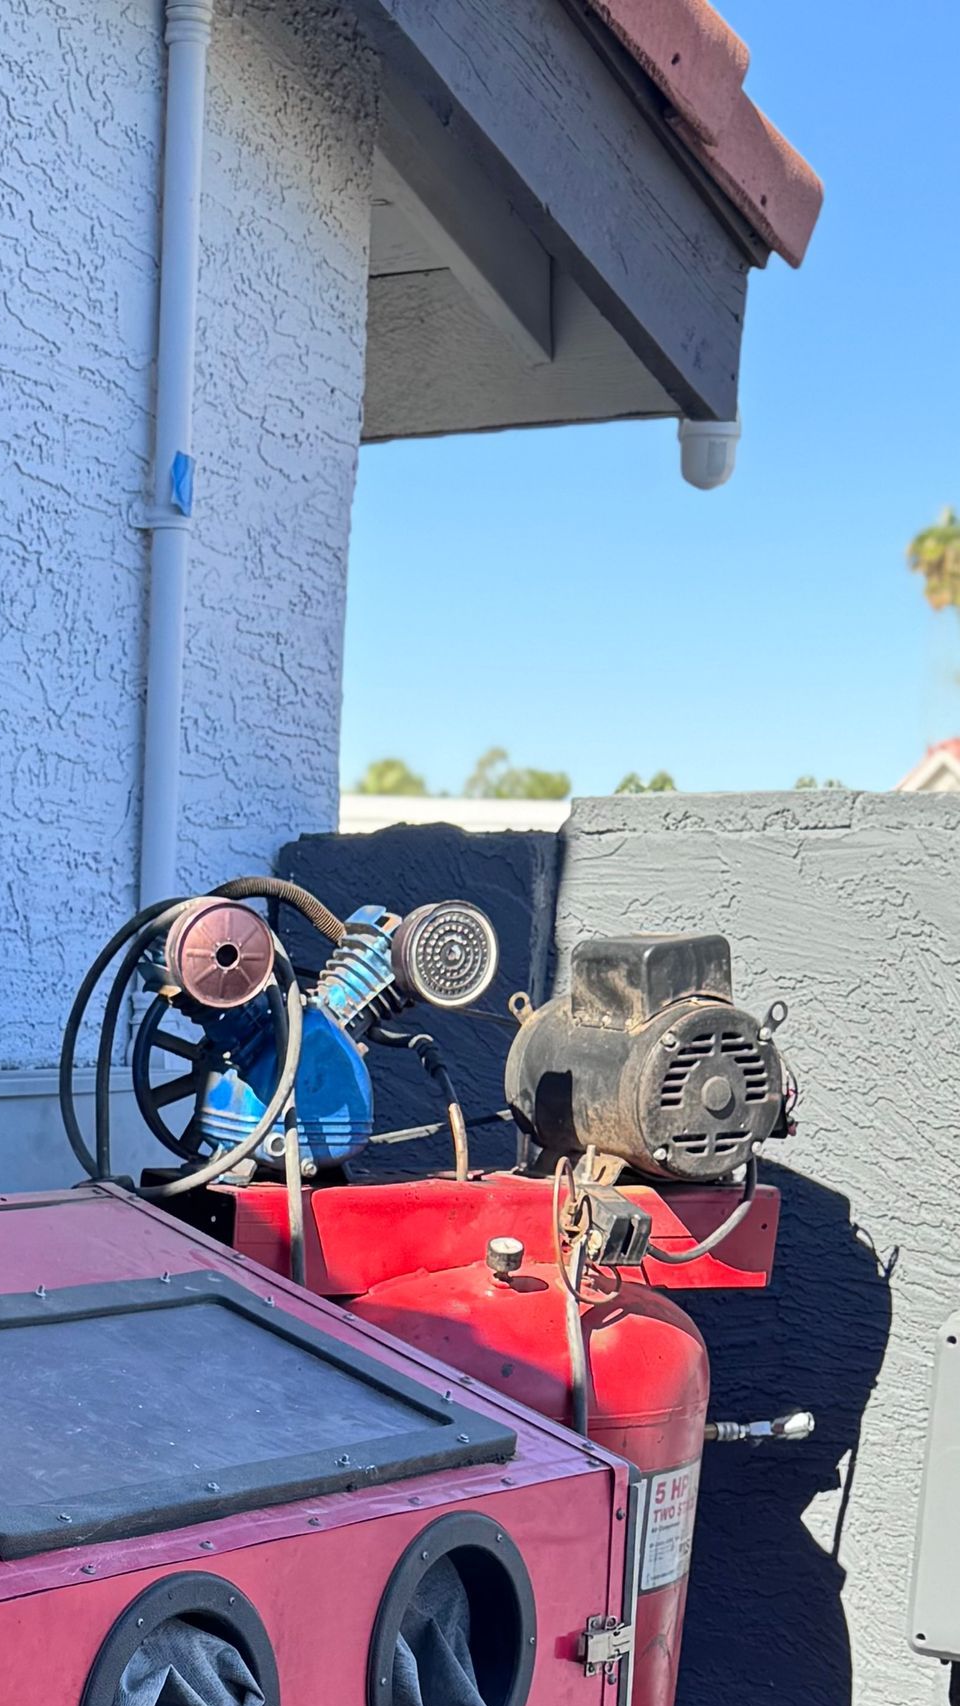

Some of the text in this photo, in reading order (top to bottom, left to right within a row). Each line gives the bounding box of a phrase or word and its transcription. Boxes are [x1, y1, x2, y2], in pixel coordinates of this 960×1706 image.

[655, 1475, 689, 1504] 5 HP
[653, 1506, 675, 1523] TWO
